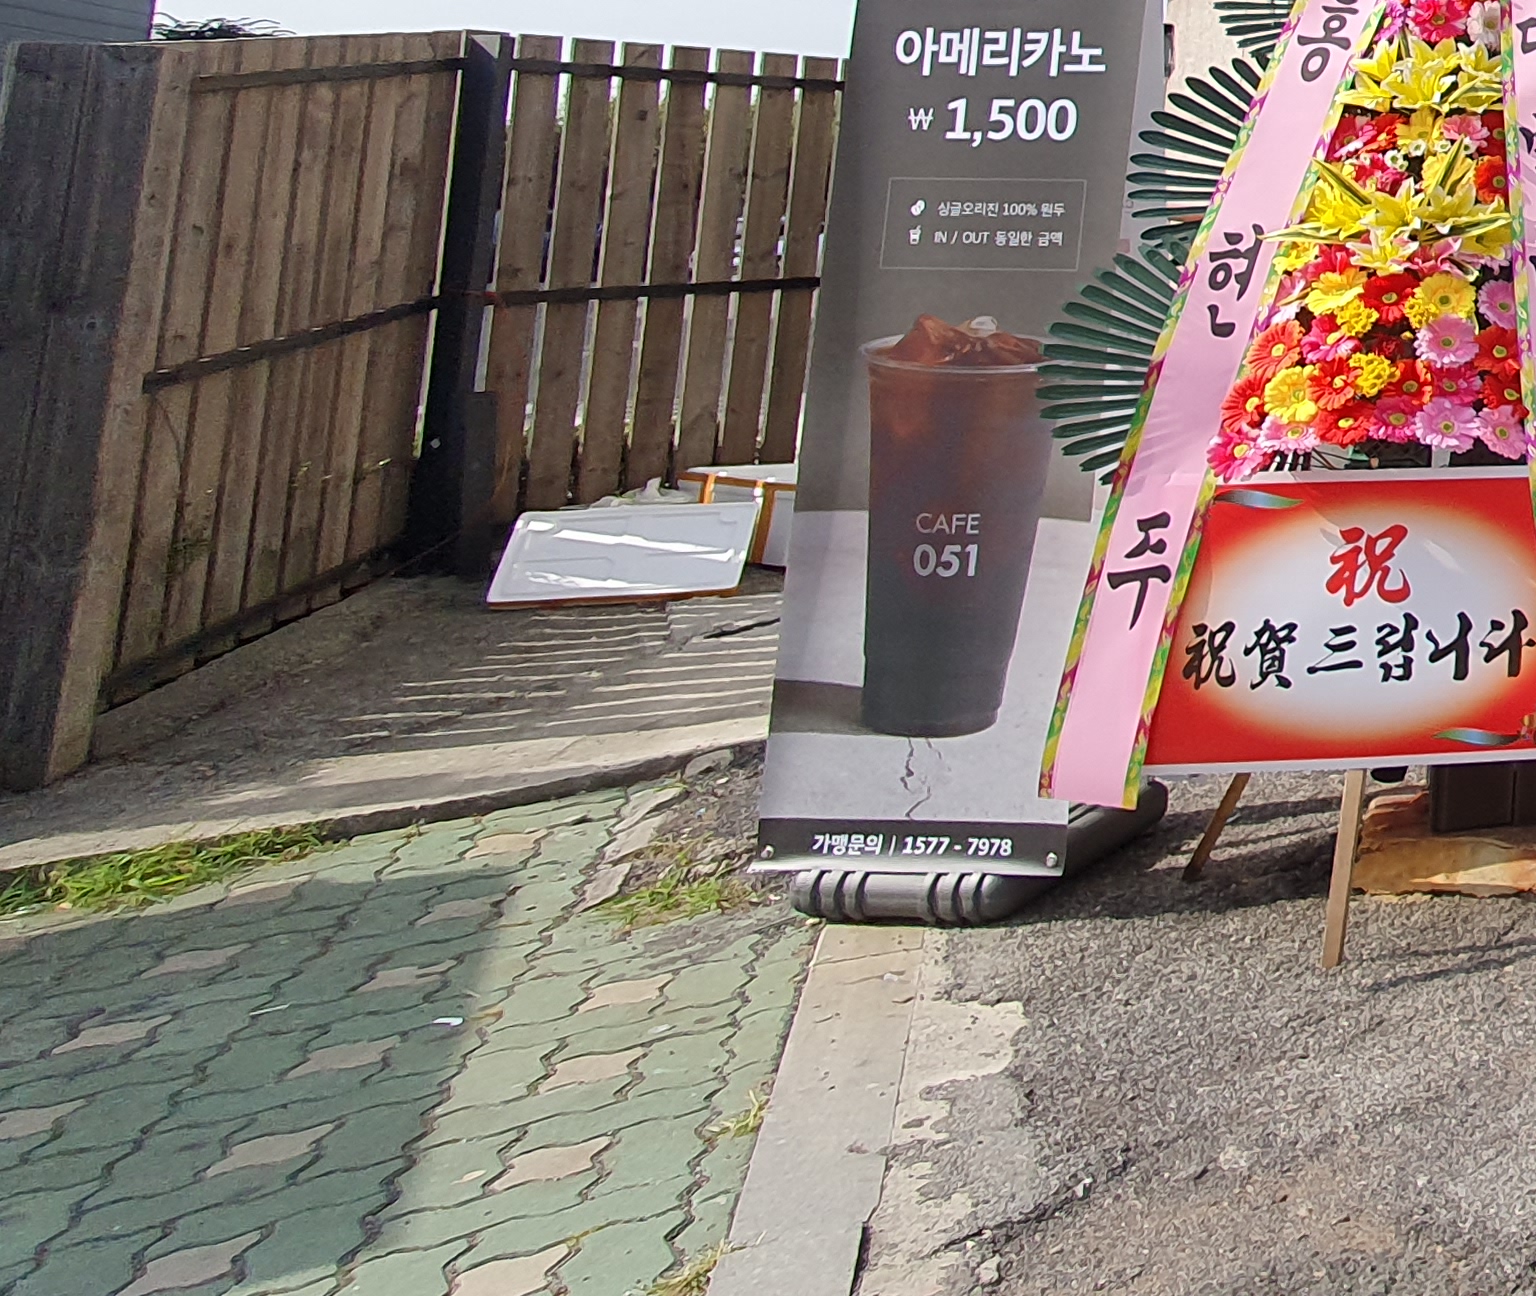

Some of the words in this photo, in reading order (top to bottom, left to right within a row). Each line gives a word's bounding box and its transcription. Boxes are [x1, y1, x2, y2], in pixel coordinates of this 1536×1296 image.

[895, 26, 1107, 77] 아메리카노
[944, 96, 1078, 148] 1,500
[936, 201, 1000, 218] 싱글오리진
[1001, 202, 1039, 217] 100%
[1040, 202, 1067, 218] 원두
[962, 231, 991, 245] OUT
[994, 231, 1034, 247] 동일한
[1037, 231, 1064, 247] 금액
[915, 512, 981, 535] CAFE
[912, 543, 978, 577] 051
[1325, 523, 1412, 607] 祝
[811, 832, 884, 856] 가맹문의
[901, 835, 951, 855] 1577
[966, 837, 1013, 857] 7978
